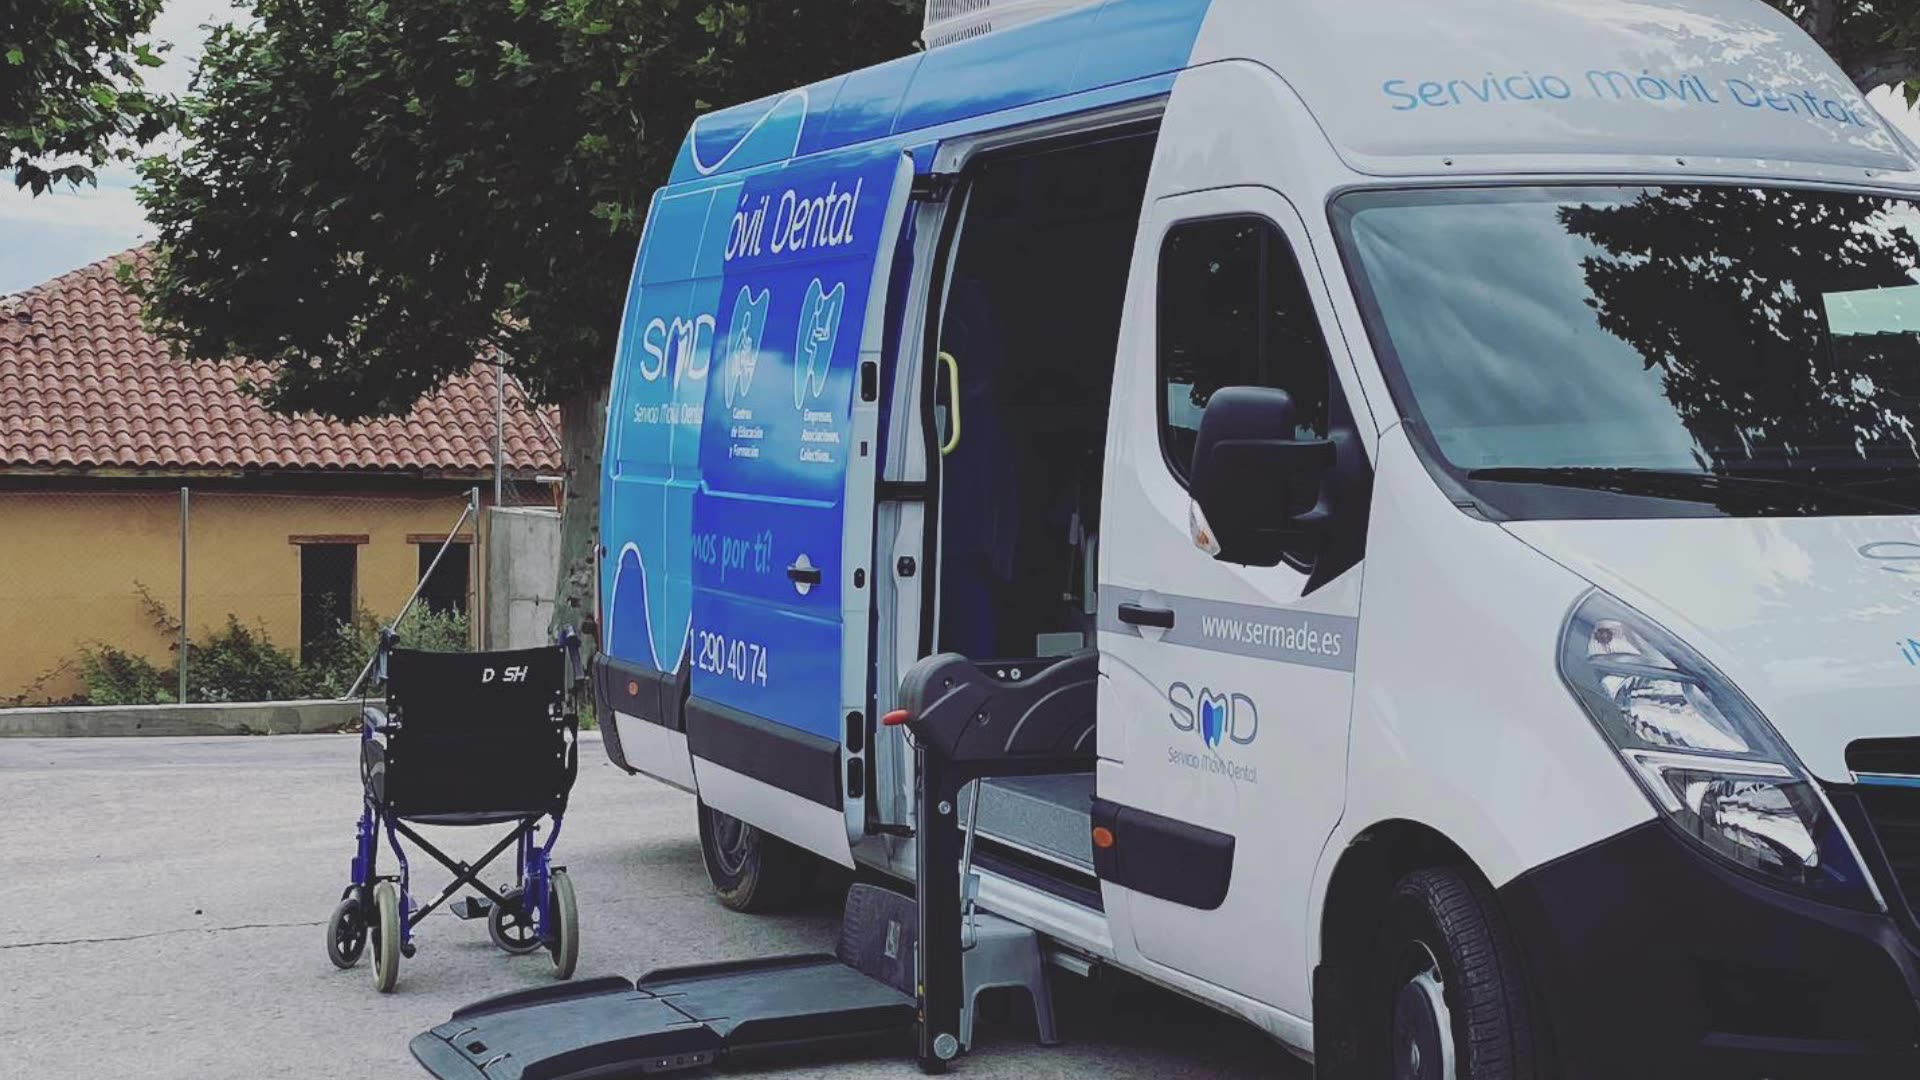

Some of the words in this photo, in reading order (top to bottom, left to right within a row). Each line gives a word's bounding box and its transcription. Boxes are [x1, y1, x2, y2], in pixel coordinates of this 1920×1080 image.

[1382, 71, 1571, 111] Servicio
[1725, 79, 1866, 128] Dental
[771, 177, 862, 253] Dental
[721, 535, 751, 583] por
[699, 631, 725, 674] 290
[727, 639, 747, 683] 40
[750, 643, 769, 688] 74
[1202, 615, 1341, 655] www.sermade.es
[1168, 681, 1258, 749] SMD
